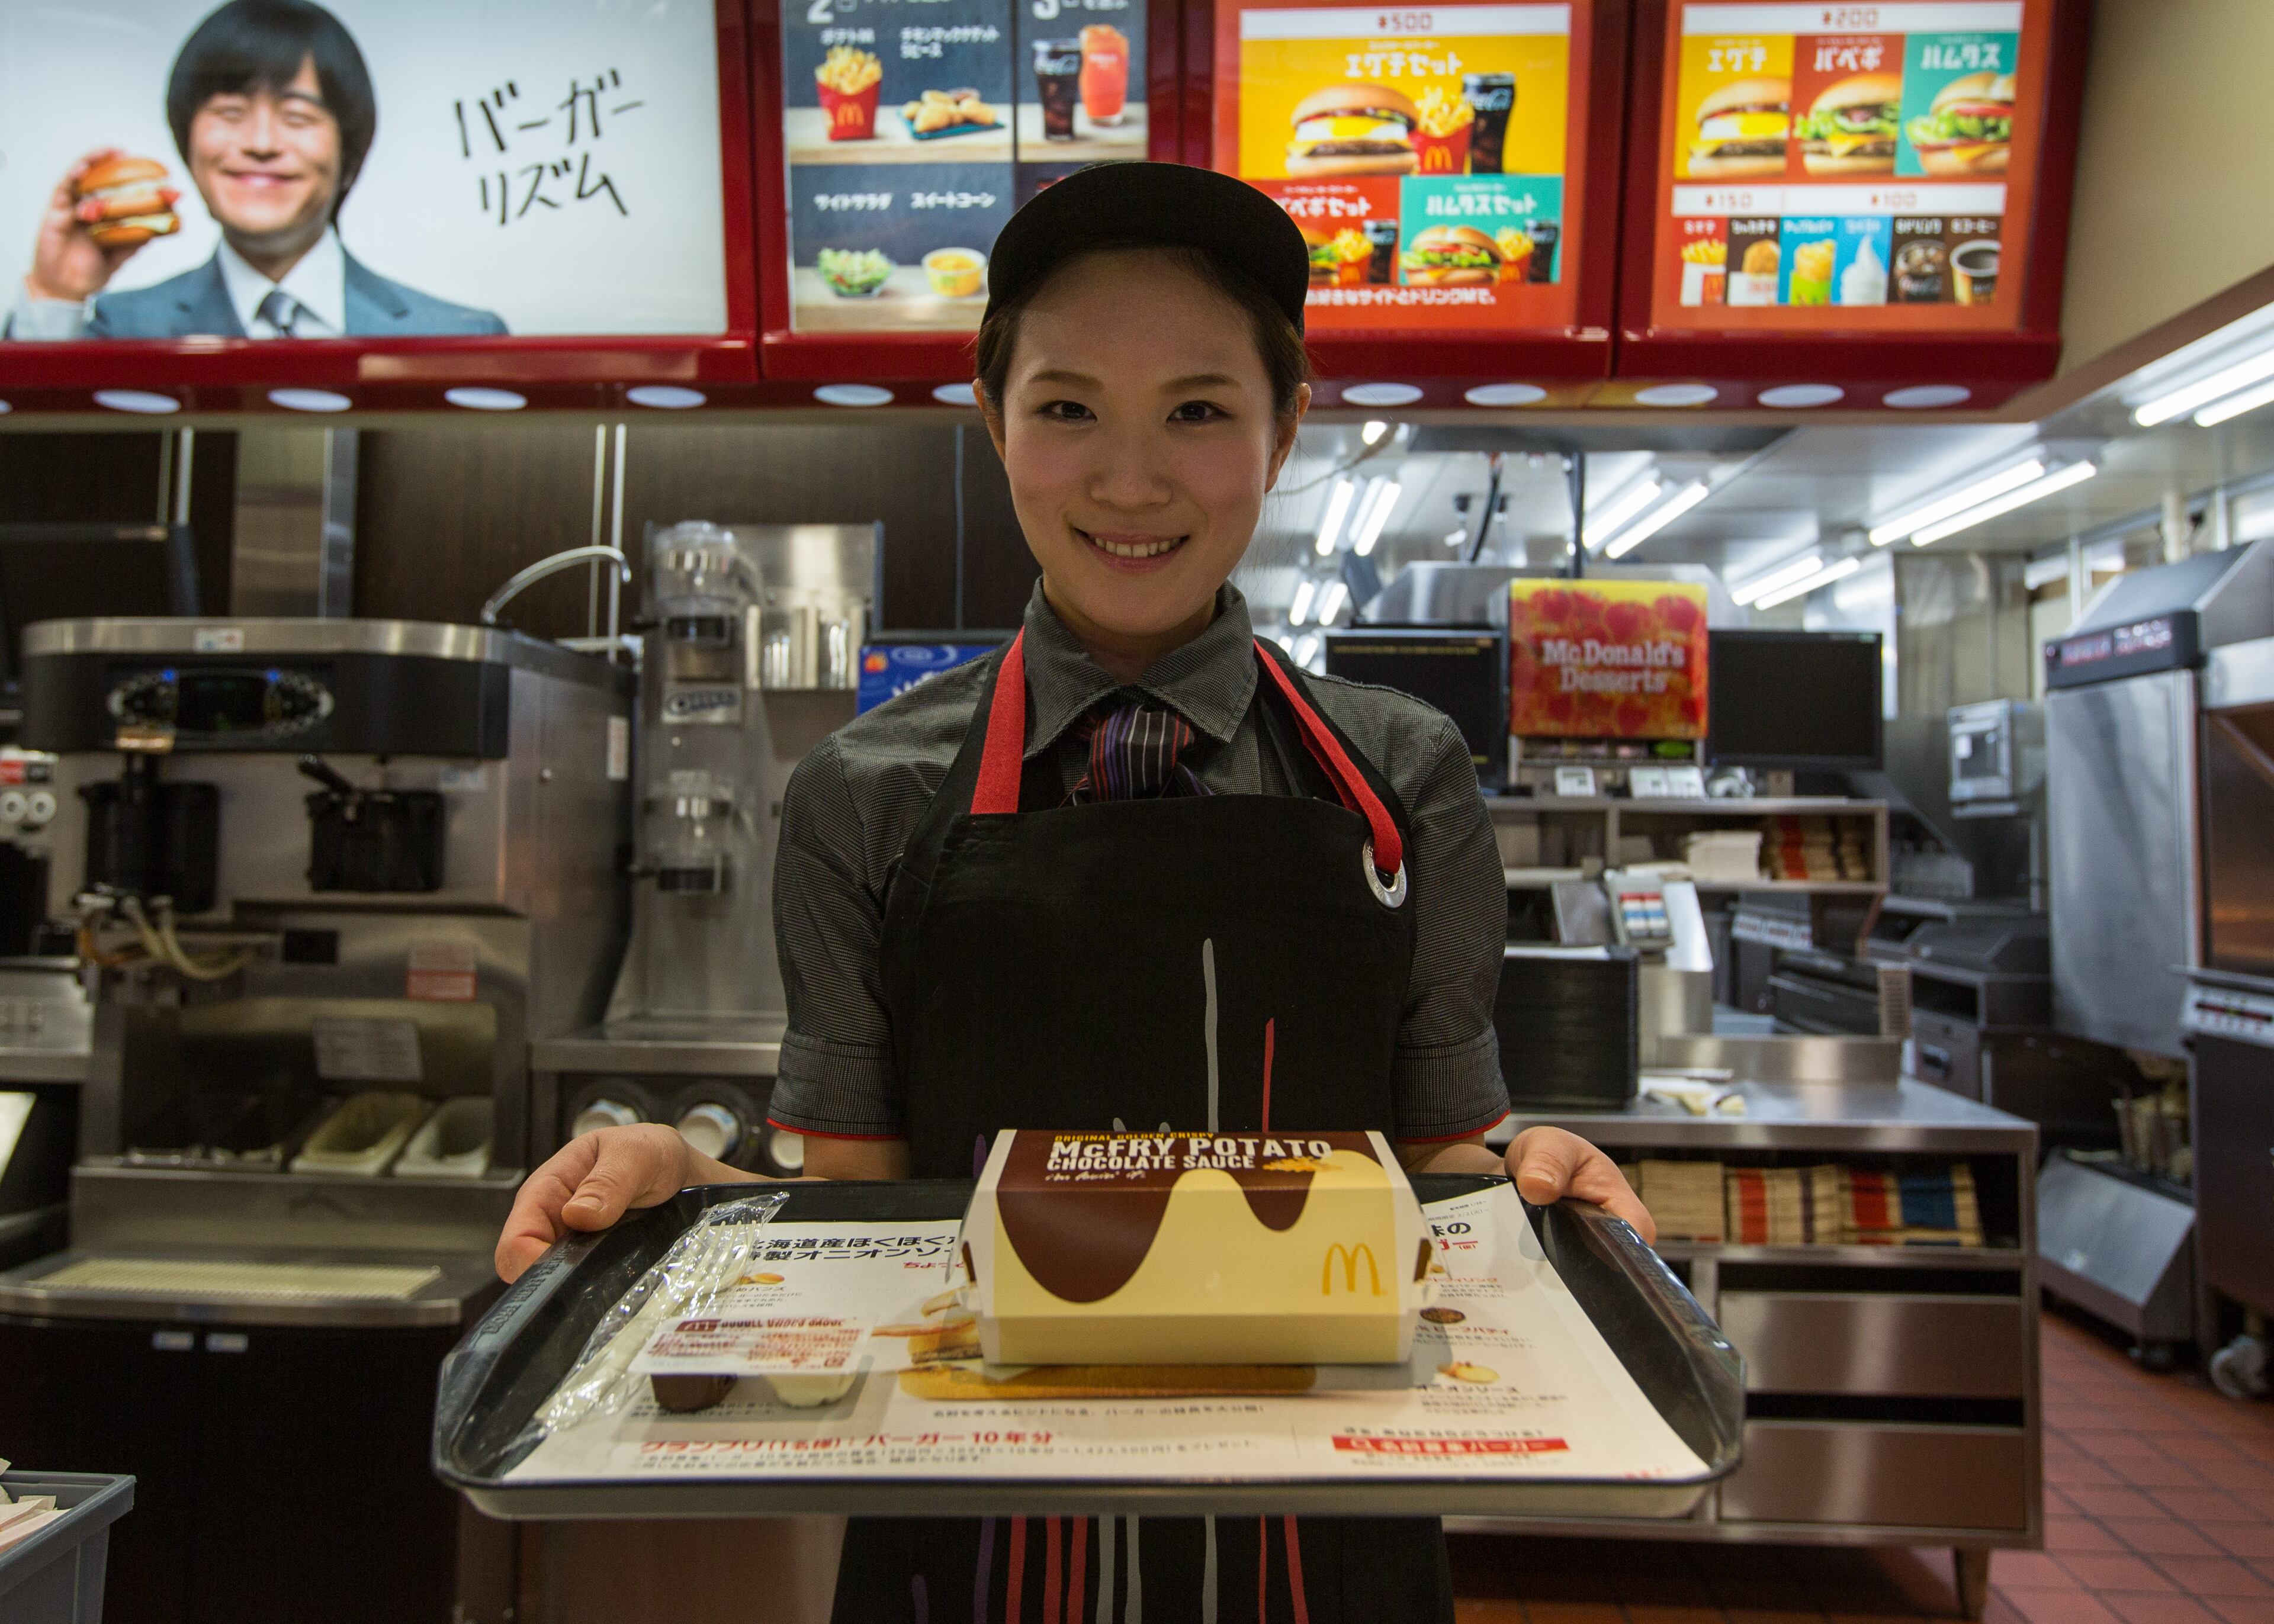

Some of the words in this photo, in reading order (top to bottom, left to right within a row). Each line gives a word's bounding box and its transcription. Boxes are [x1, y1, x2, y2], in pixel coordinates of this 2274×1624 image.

[1377, 12, 1434, 31] ¥500
[1822, 8, 1880, 28] ¥200
[1345, 51, 1463, 78] エグチセット
[1707, 47, 1768, 72] エグチ
[1920, 43, 2002, 70] ハムタス
[452, 66, 647, 159] バーガー
[479, 151, 629, 227] リズム
[1425, 192, 1539, 217] ハムタスセット
[1541, 638, 1685, 668] McDonald's
[1560, 667, 1668, 693] Desserts
[1049, 1137, 1175, 1159] McFRY
[1189, 1137, 1333, 1158] POTATO
[1117, 1132, 1165, 1140] GOLDEN
[1046, 1155, 1176, 1171] CHOCOLATE
[1183, 1155, 1256, 1169] SAUCE
